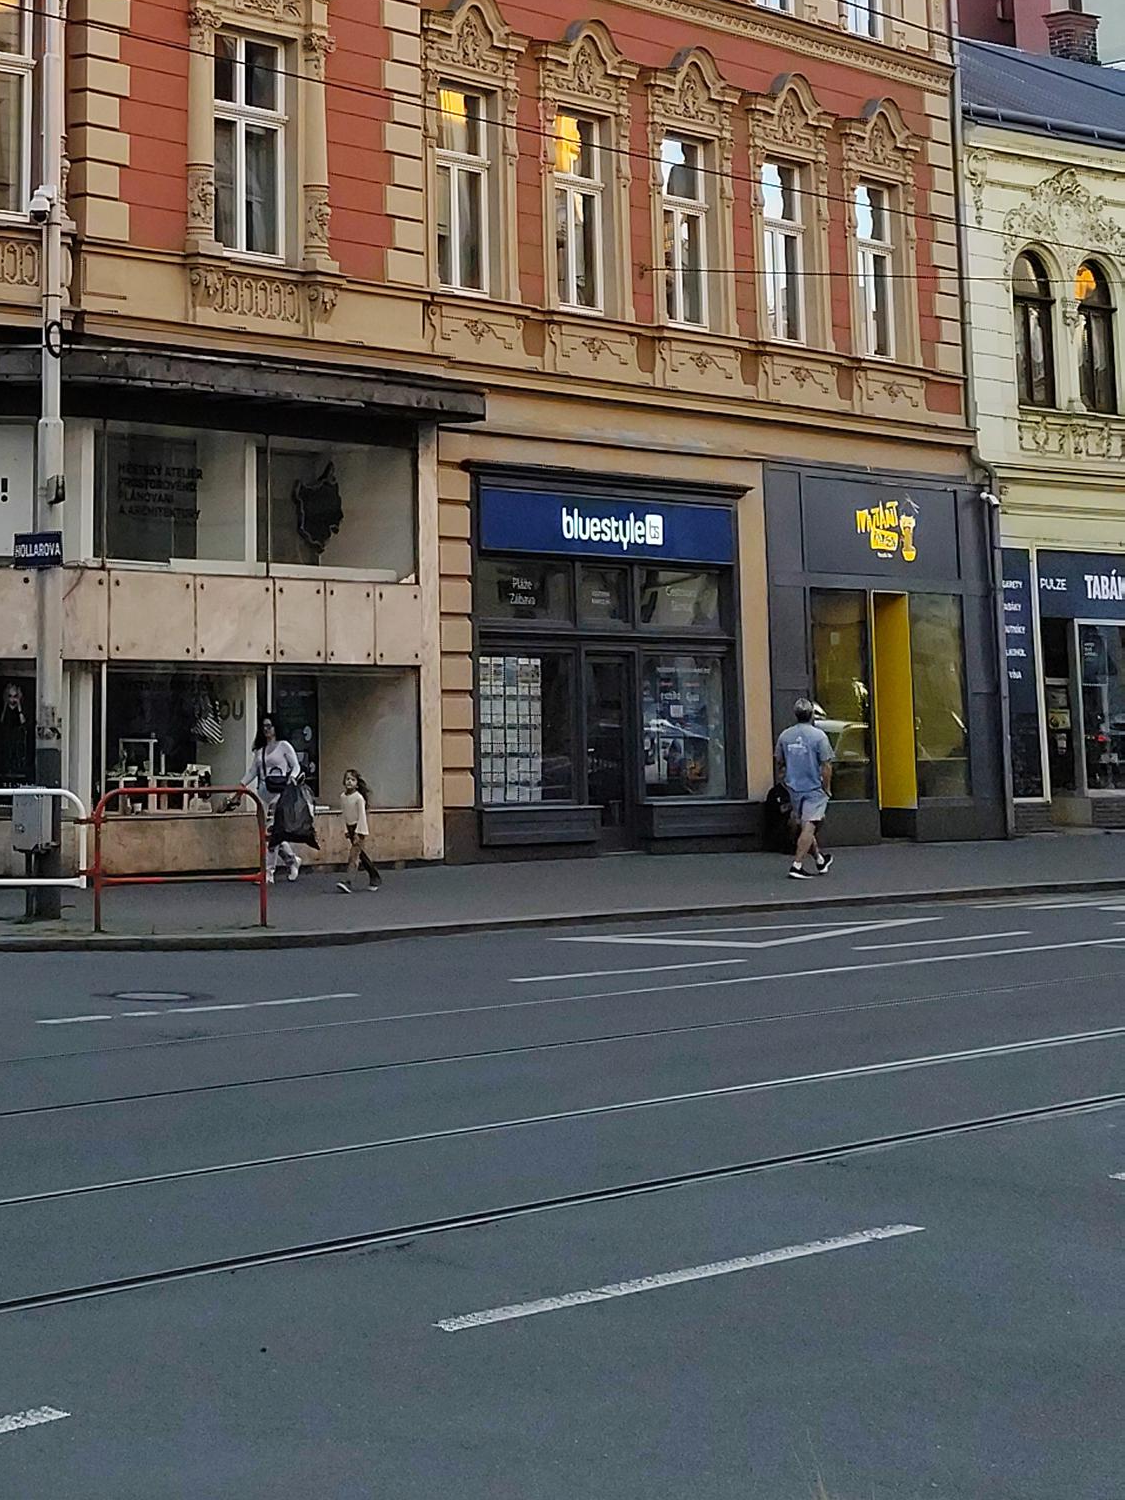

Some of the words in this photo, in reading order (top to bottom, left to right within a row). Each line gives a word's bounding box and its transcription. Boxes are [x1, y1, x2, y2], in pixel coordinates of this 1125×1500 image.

[562, 507, 645, 550] bluestyle
[15, 542, 62, 558] HOLLAROVA
[1039, 577, 1067, 591] PULZE
